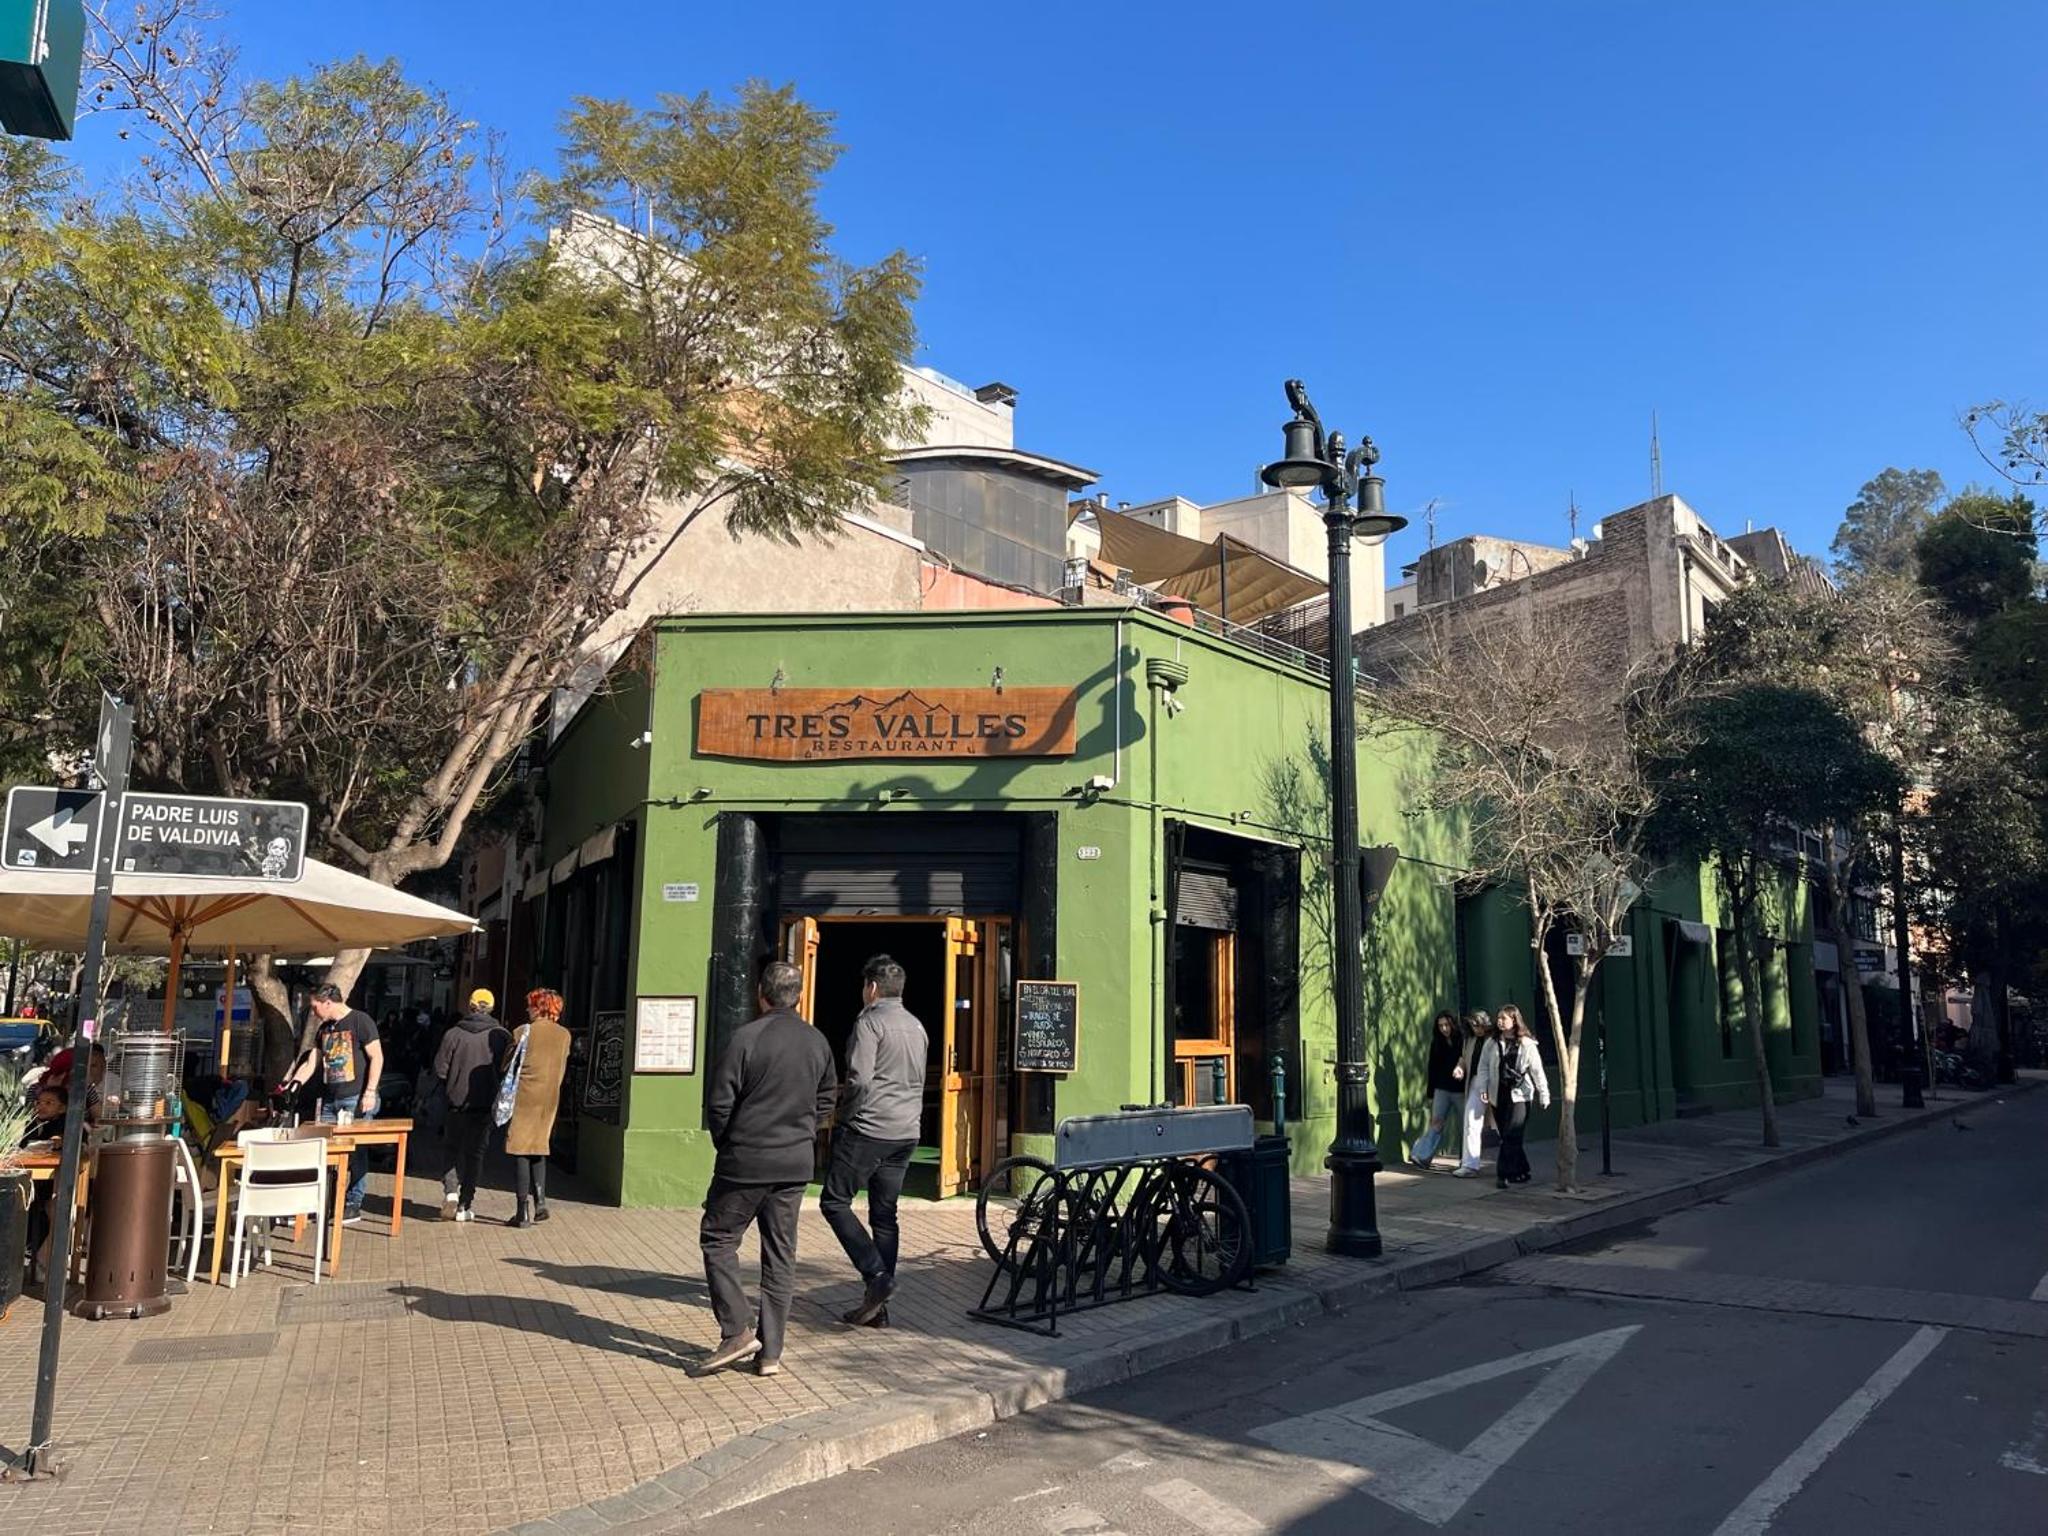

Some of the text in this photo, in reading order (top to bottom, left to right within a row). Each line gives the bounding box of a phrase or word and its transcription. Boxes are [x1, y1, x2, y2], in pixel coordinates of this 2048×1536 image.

[746, 714, 1027, 738] TRES VALLES
[812, 740, 958, 751] RESTAURANT
[131, 804, 240, 825] PADRE LUIS
[127, 826, 241, 846] DE VALDIVIA
